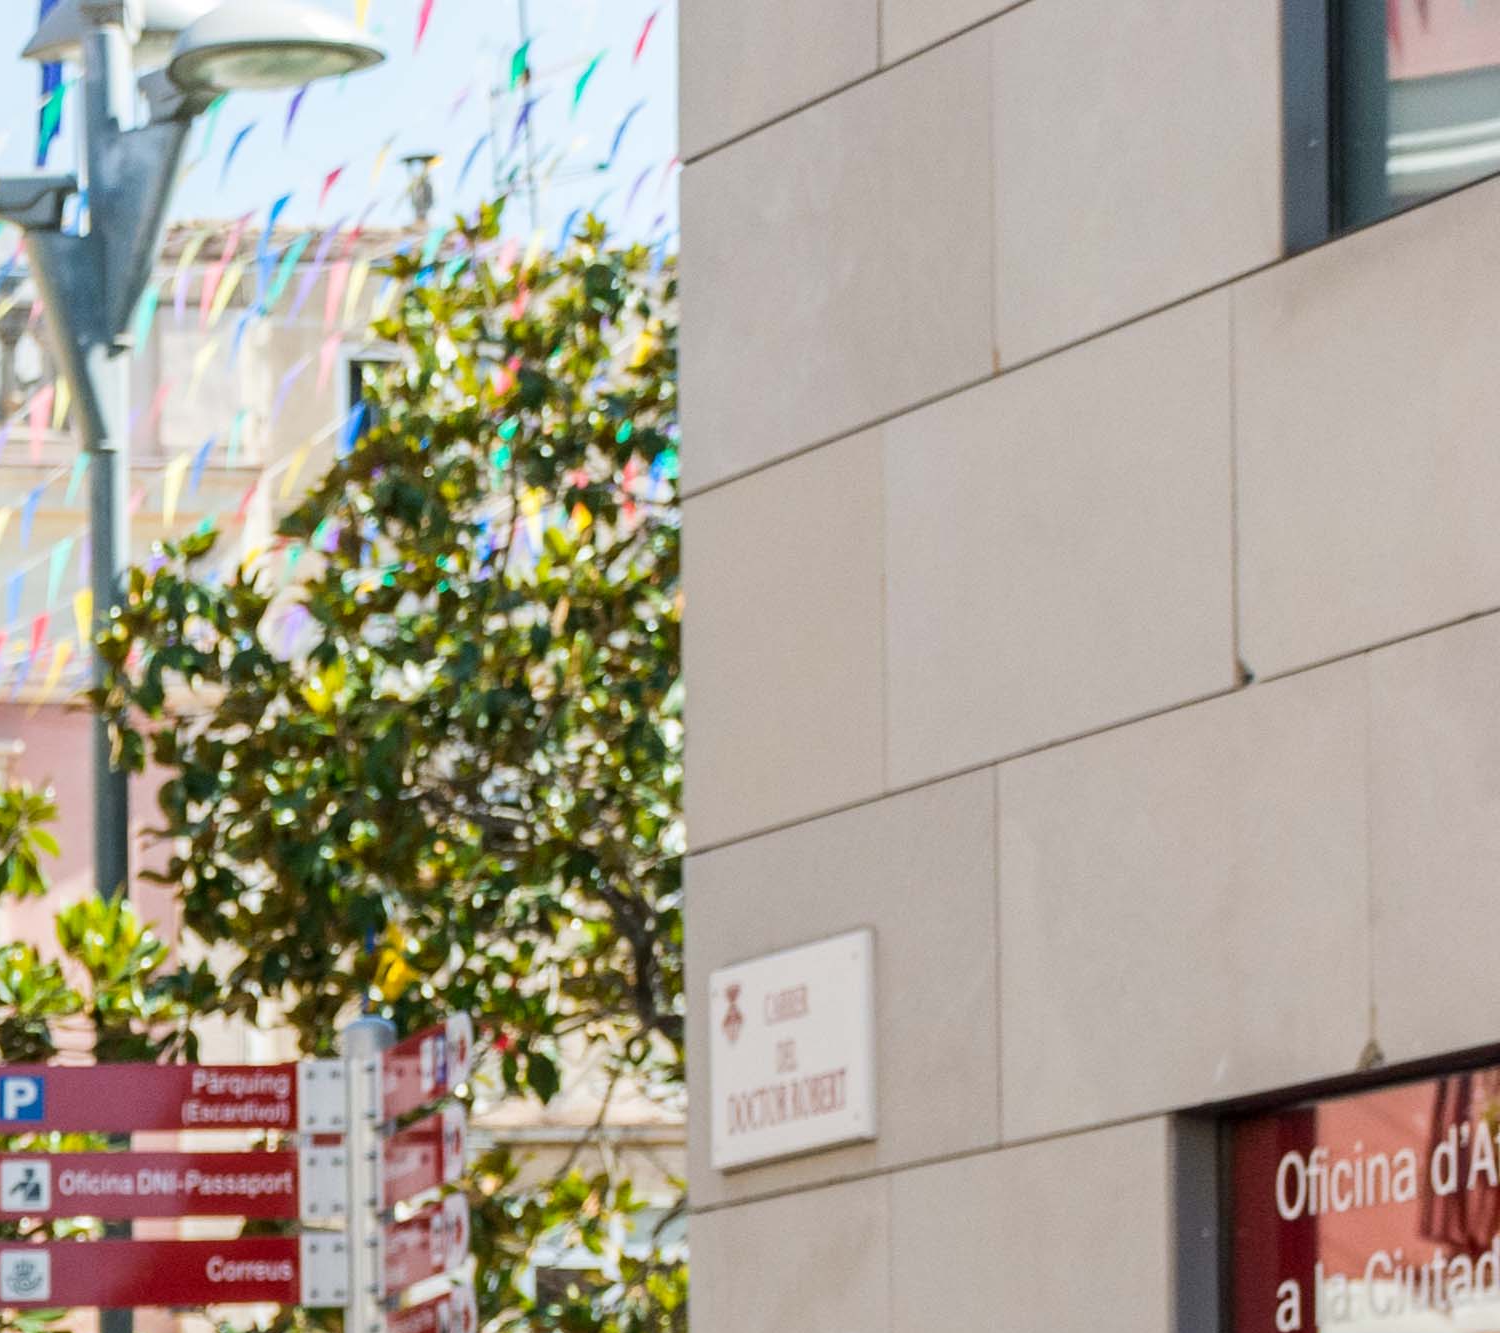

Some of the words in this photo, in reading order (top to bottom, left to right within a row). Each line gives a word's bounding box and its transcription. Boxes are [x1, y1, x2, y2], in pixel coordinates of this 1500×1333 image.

[726, 1083, 788, 1136] DOCTOR
[789, 1067, 846, 1119] ROBERT
[58, 1169, 133, 1196] Oficina
[136, 1169, 293, 1199] DNI-Passaport
[1275, 1140, 1417, 1221] Oficina
[1431, 1120, 1500, 1196] d'A
[205, 1255, 293, 1283] Correus
[1275, 1279, 1301, 1333] a
[1314, 1262, 1349, 1328] la
